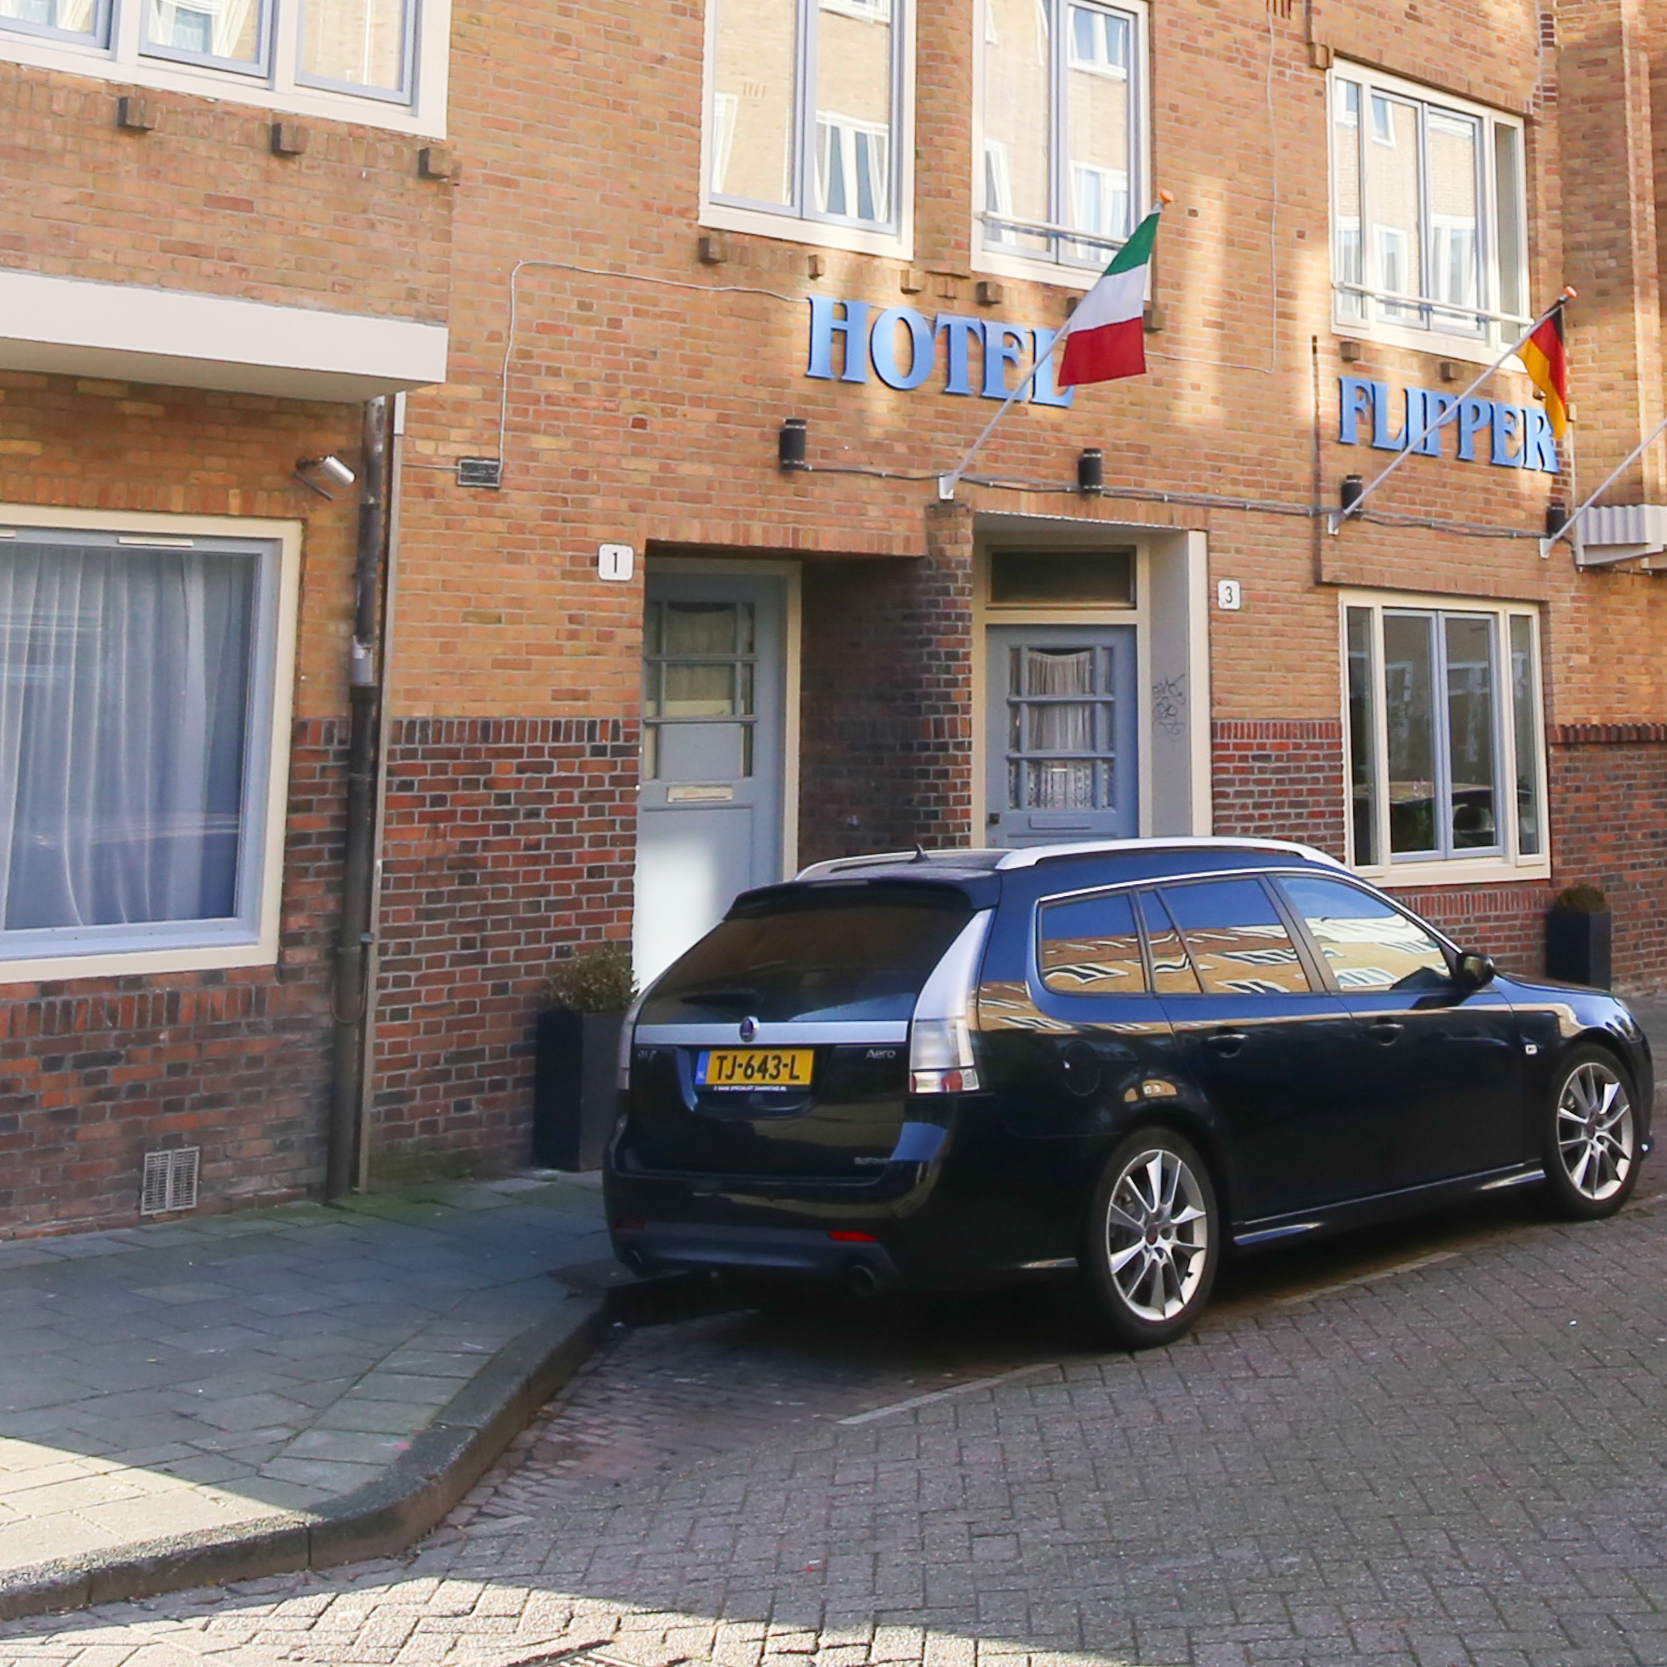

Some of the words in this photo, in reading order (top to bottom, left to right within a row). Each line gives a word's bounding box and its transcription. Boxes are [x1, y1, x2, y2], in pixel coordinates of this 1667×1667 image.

[806, 294, 1076, 408] HOTEL
[1339, 375, 1561, 473] FLIPPER
[612, 551, 619, 574] 1
[1224, 585, 1233, 604] 3
[866, 1049, 896, 1059] Aero
[716, 1054, 801, 1081] TJ-643-L
